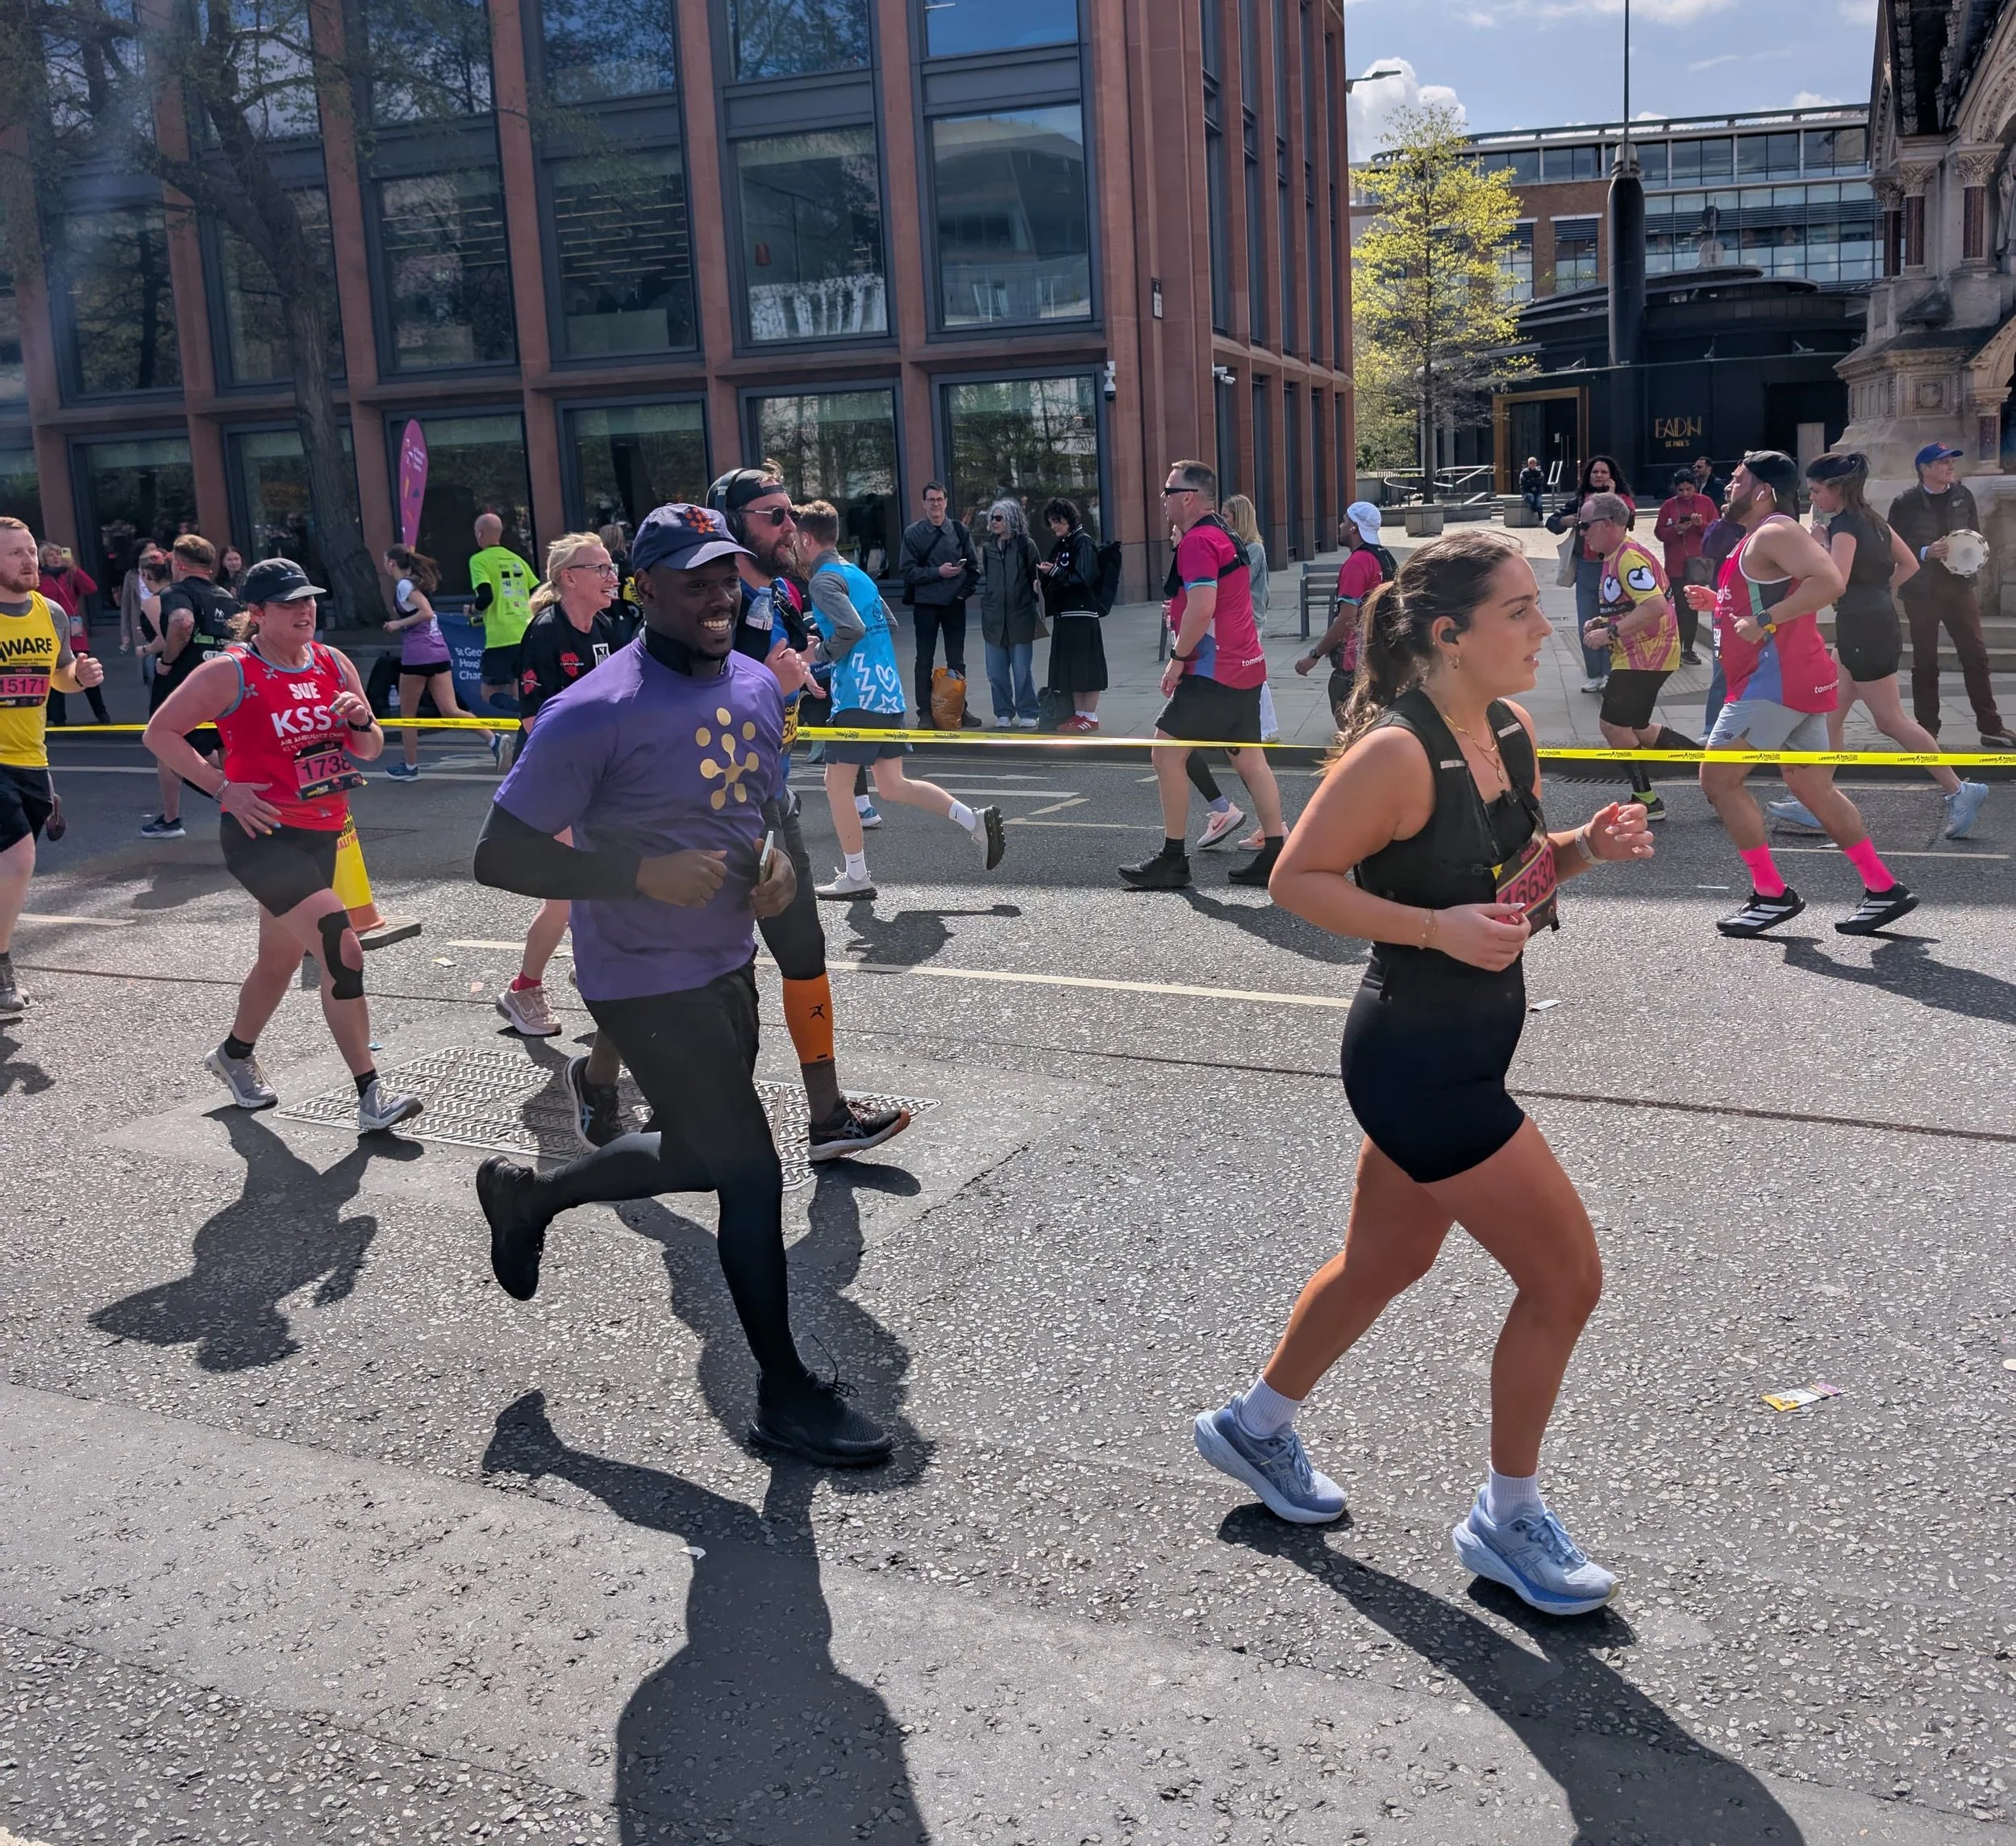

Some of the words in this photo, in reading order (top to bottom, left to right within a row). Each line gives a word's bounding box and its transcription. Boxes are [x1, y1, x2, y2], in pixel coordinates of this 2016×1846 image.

[464, 648, 485, 656] Geo
[460, 659, 481, 669] Hosp
[289, 681, 321, 700] SUE
[271, 705, 332, 738] KSS
